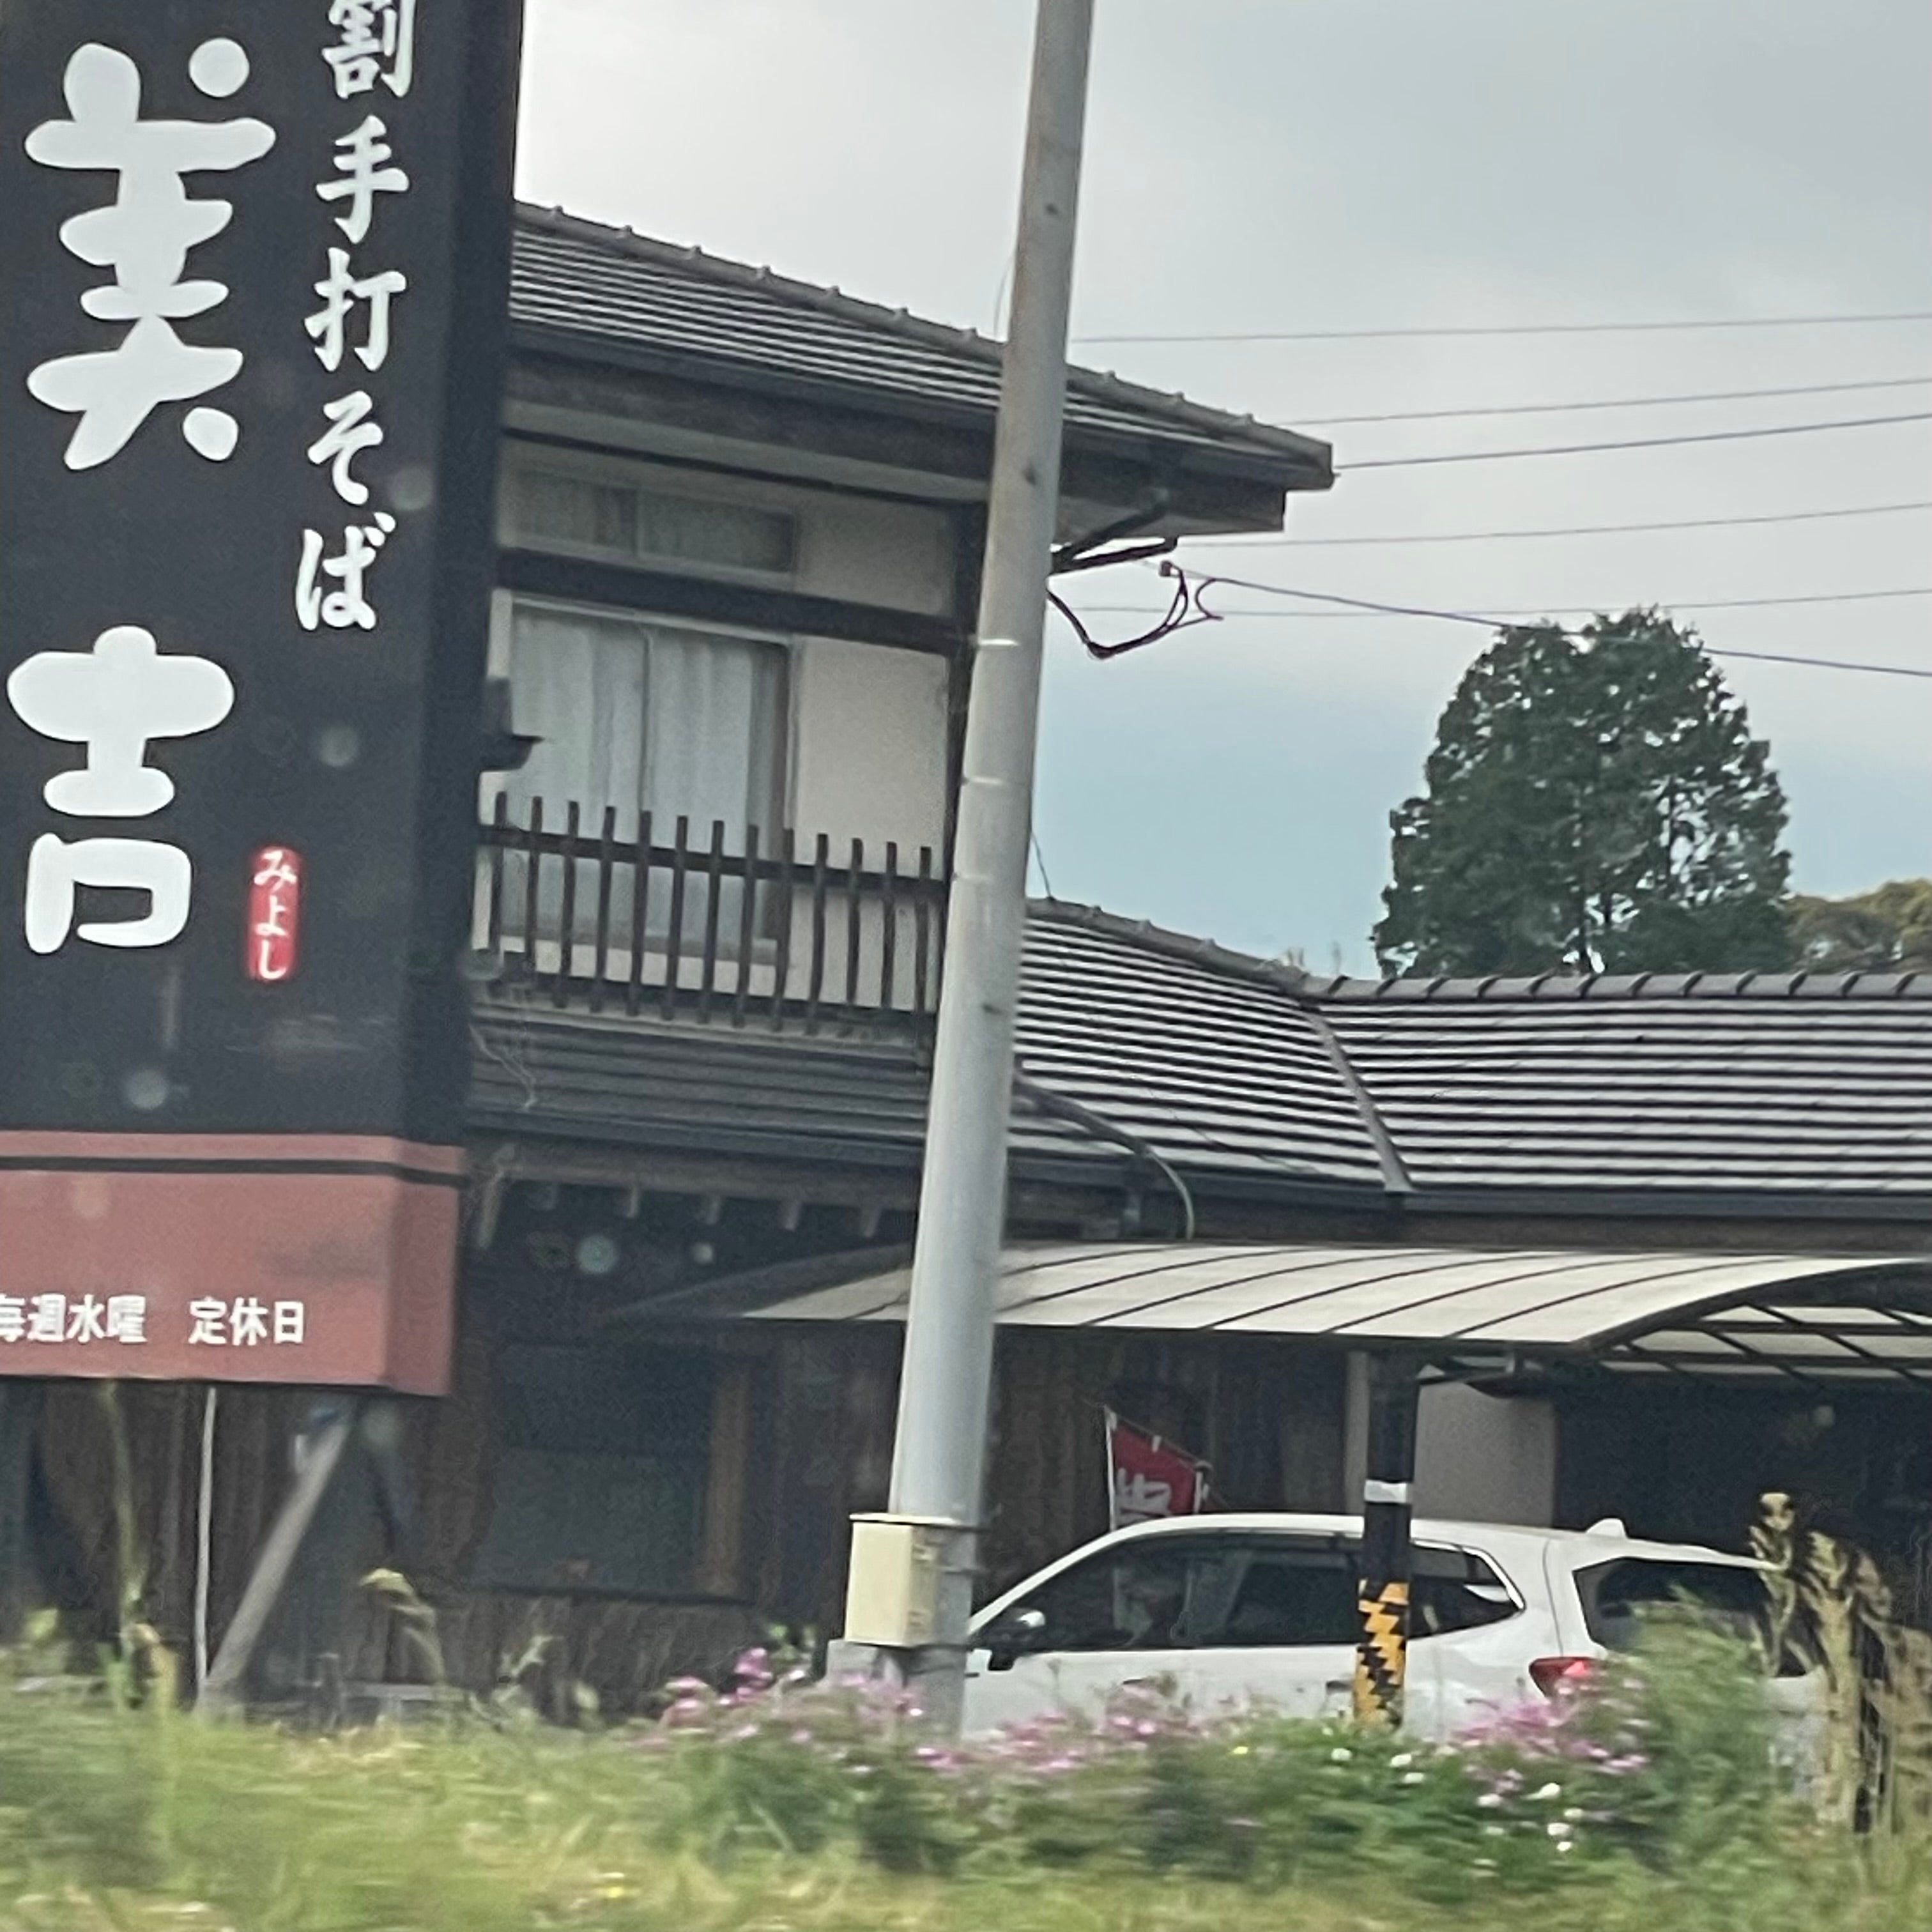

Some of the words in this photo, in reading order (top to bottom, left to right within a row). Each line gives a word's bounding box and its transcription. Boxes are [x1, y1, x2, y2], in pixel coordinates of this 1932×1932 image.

[7, 38, 276, 954] 美吉
[296, 0, 415, 630] 割手打そば
[254, 850, 296, 979] みよし
[189, 1297, 303, 1345] 定休日
